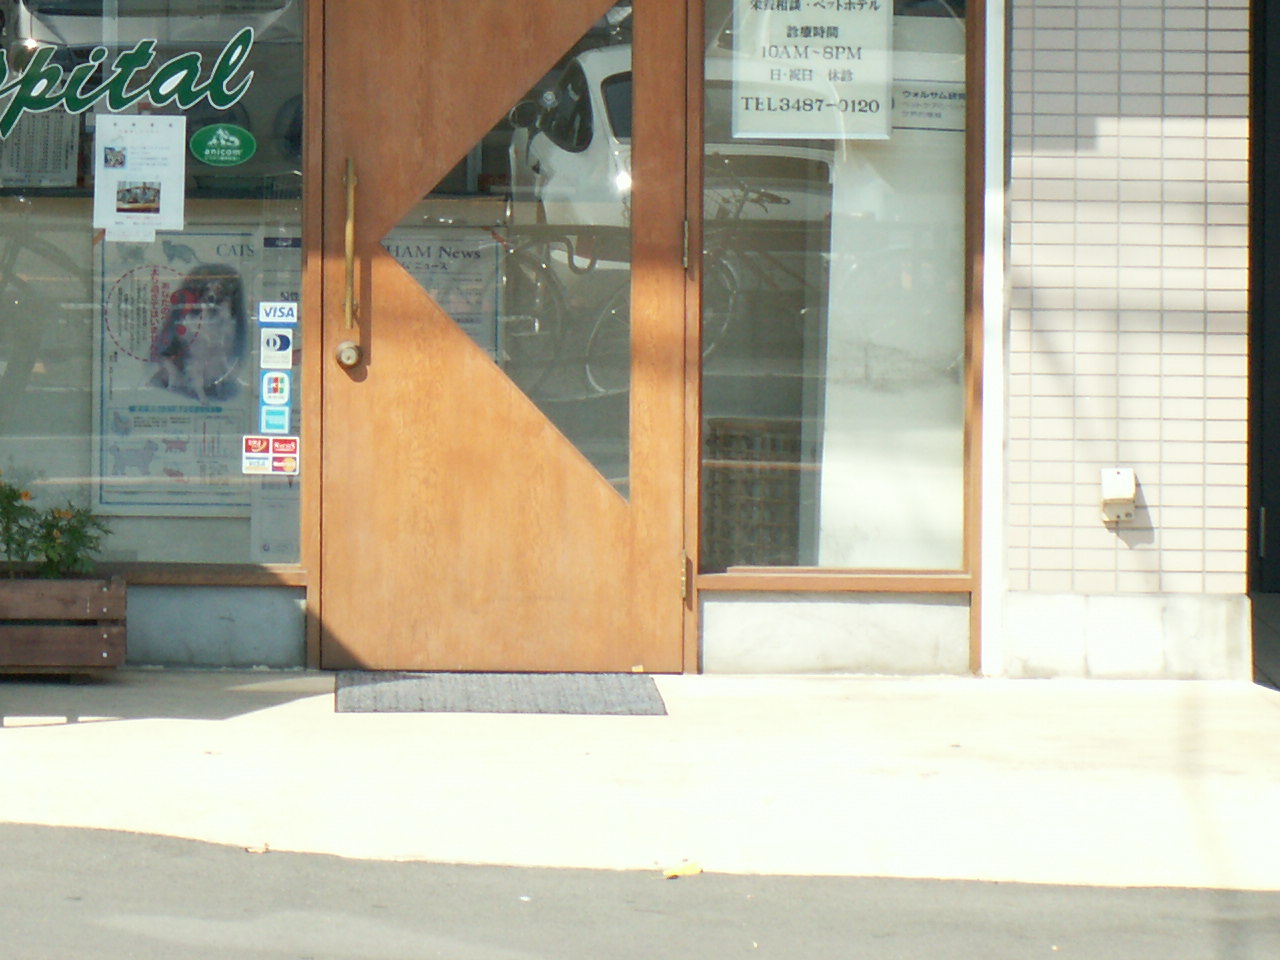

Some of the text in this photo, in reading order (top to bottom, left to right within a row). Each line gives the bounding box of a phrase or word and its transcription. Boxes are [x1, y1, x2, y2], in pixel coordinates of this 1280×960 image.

[786, 25, 840, 38] 診療時間
[204, 148, 241, 156] anicom
[216, 243, 256, 257] CATS
[438, 246, 481, 260] News
[264, 306, 295, 318] VISA
